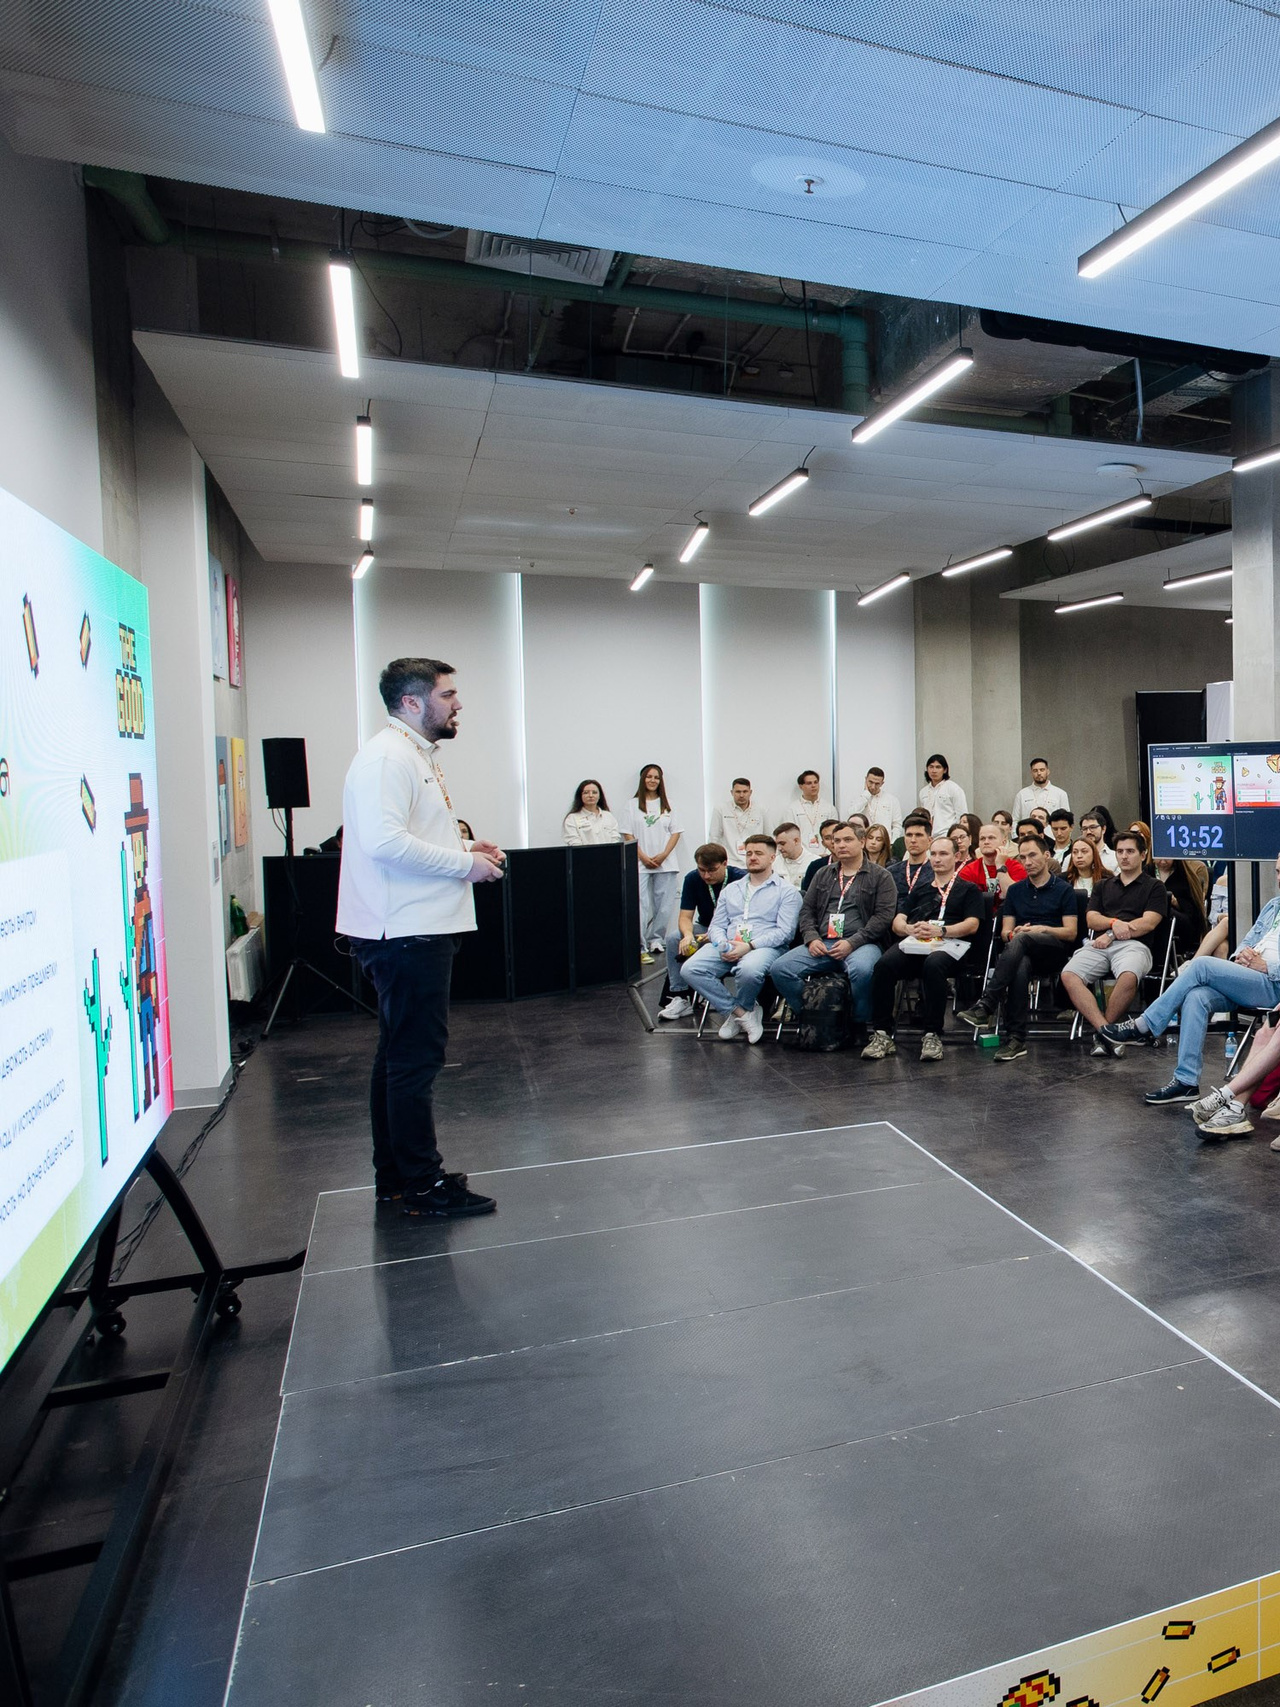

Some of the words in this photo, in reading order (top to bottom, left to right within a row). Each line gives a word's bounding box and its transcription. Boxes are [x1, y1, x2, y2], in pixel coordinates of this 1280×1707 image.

[119, 622, 137, 673] THE
[116, 668, 145, 740] GOOD
[1166, 825, 1224, 848] 13:52
